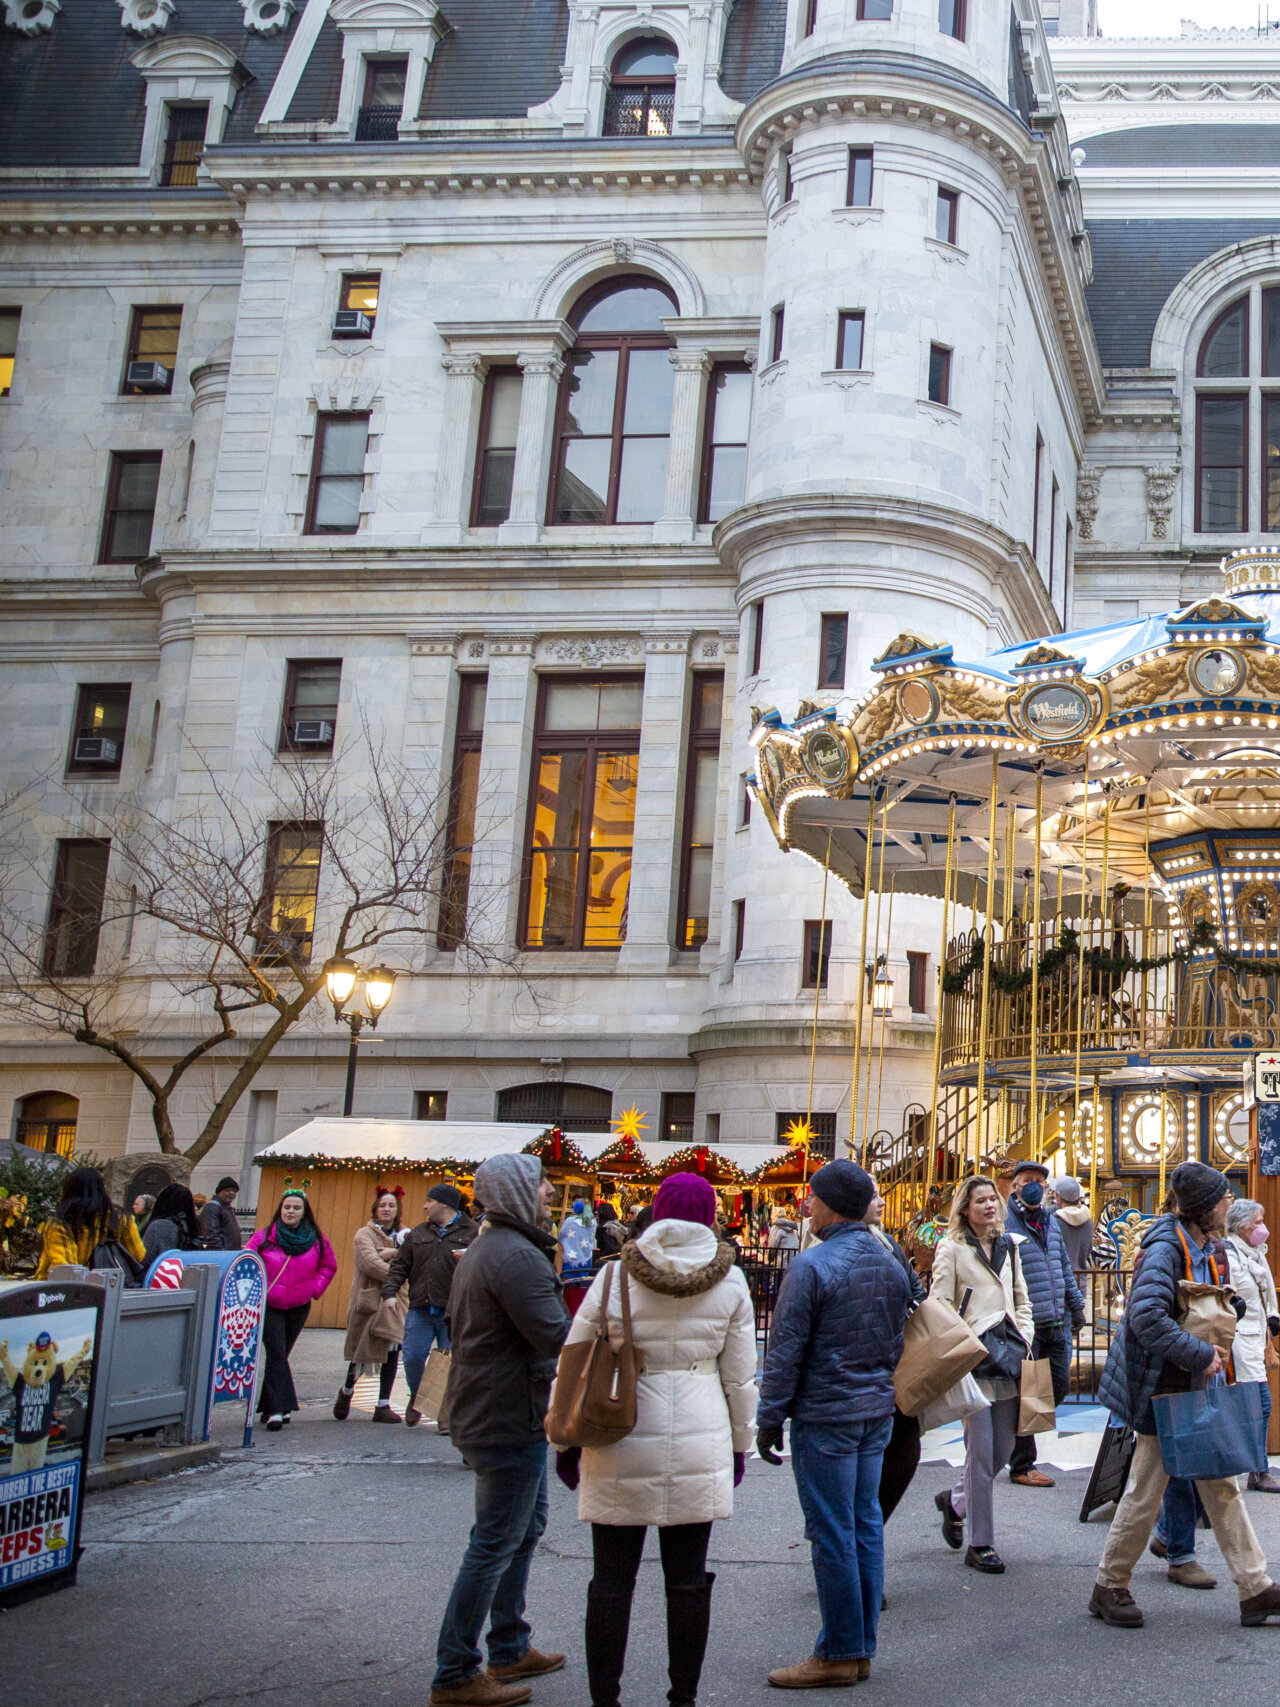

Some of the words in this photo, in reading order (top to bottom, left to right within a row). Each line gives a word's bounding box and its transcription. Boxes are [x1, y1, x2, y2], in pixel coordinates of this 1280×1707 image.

[1033, 701, 1080, 720] Westfield
[38, 1292, 66, 1307] Bigbelly
[30, 1472, 46, 1494] THE
[47, 1465, 76, 1490] BEST??
[2, 1567, 9, 1584] I
[12, 1552, 55, 1581] GUESS
